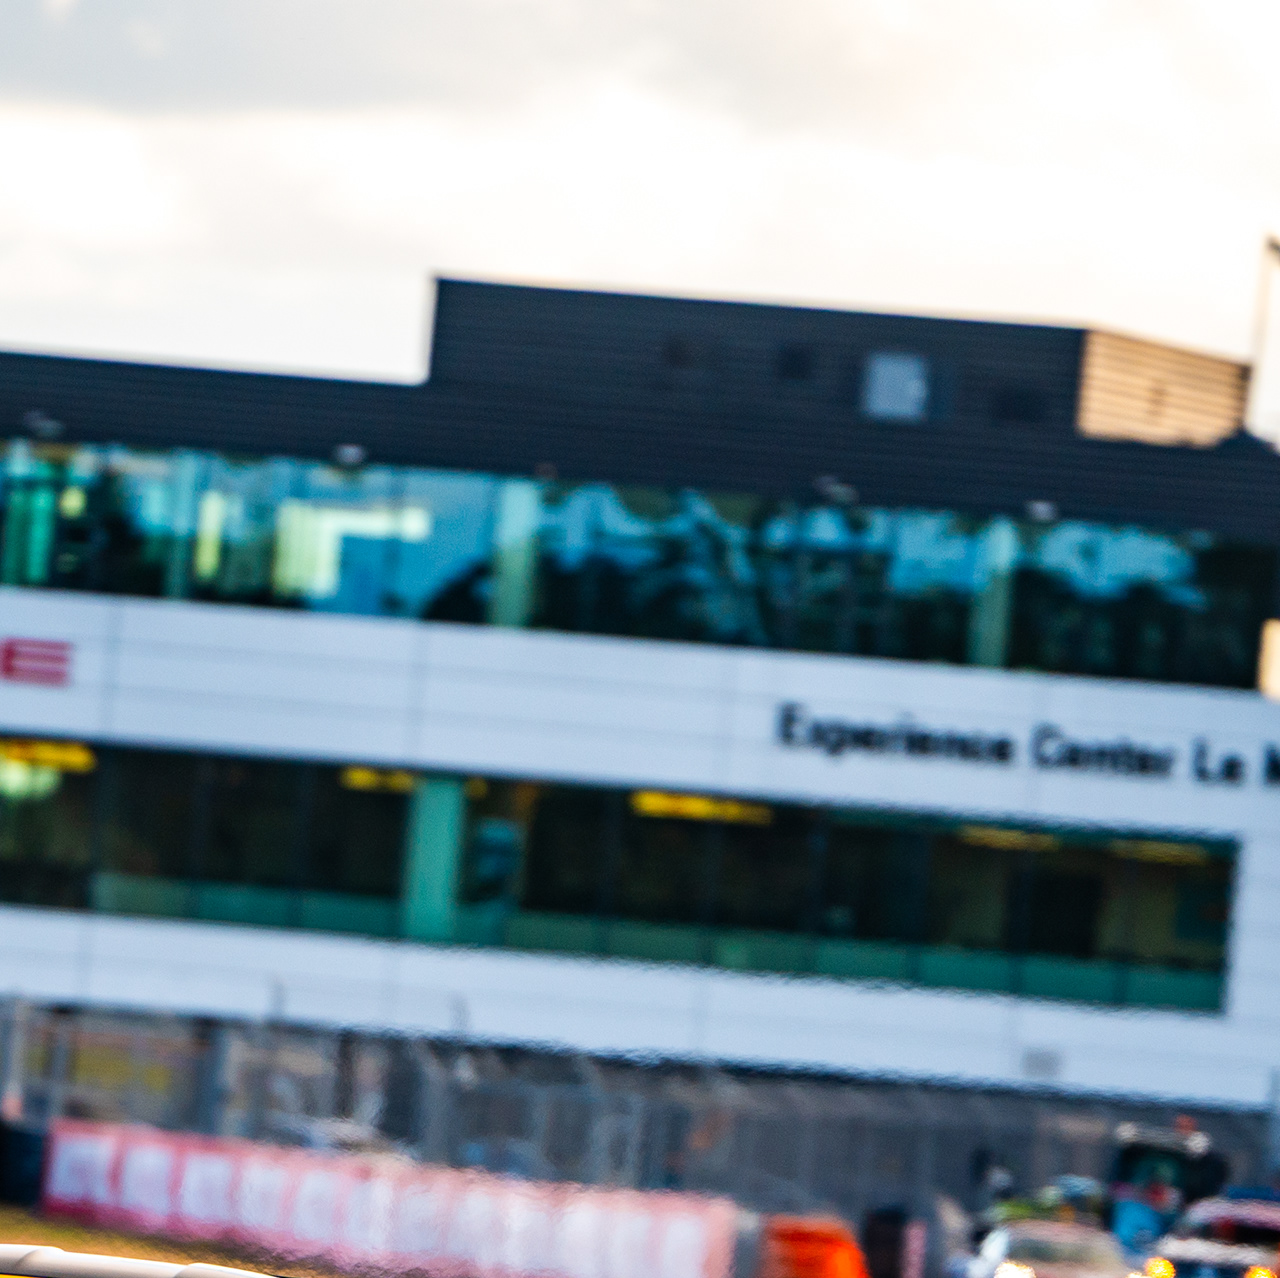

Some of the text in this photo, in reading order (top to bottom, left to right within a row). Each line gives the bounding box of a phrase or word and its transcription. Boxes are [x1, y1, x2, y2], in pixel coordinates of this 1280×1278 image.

[777, 703, 1012, 765] Experience
[1032, 721, 1176, 777] Center
[1194, 737, 1243, 786] Le
